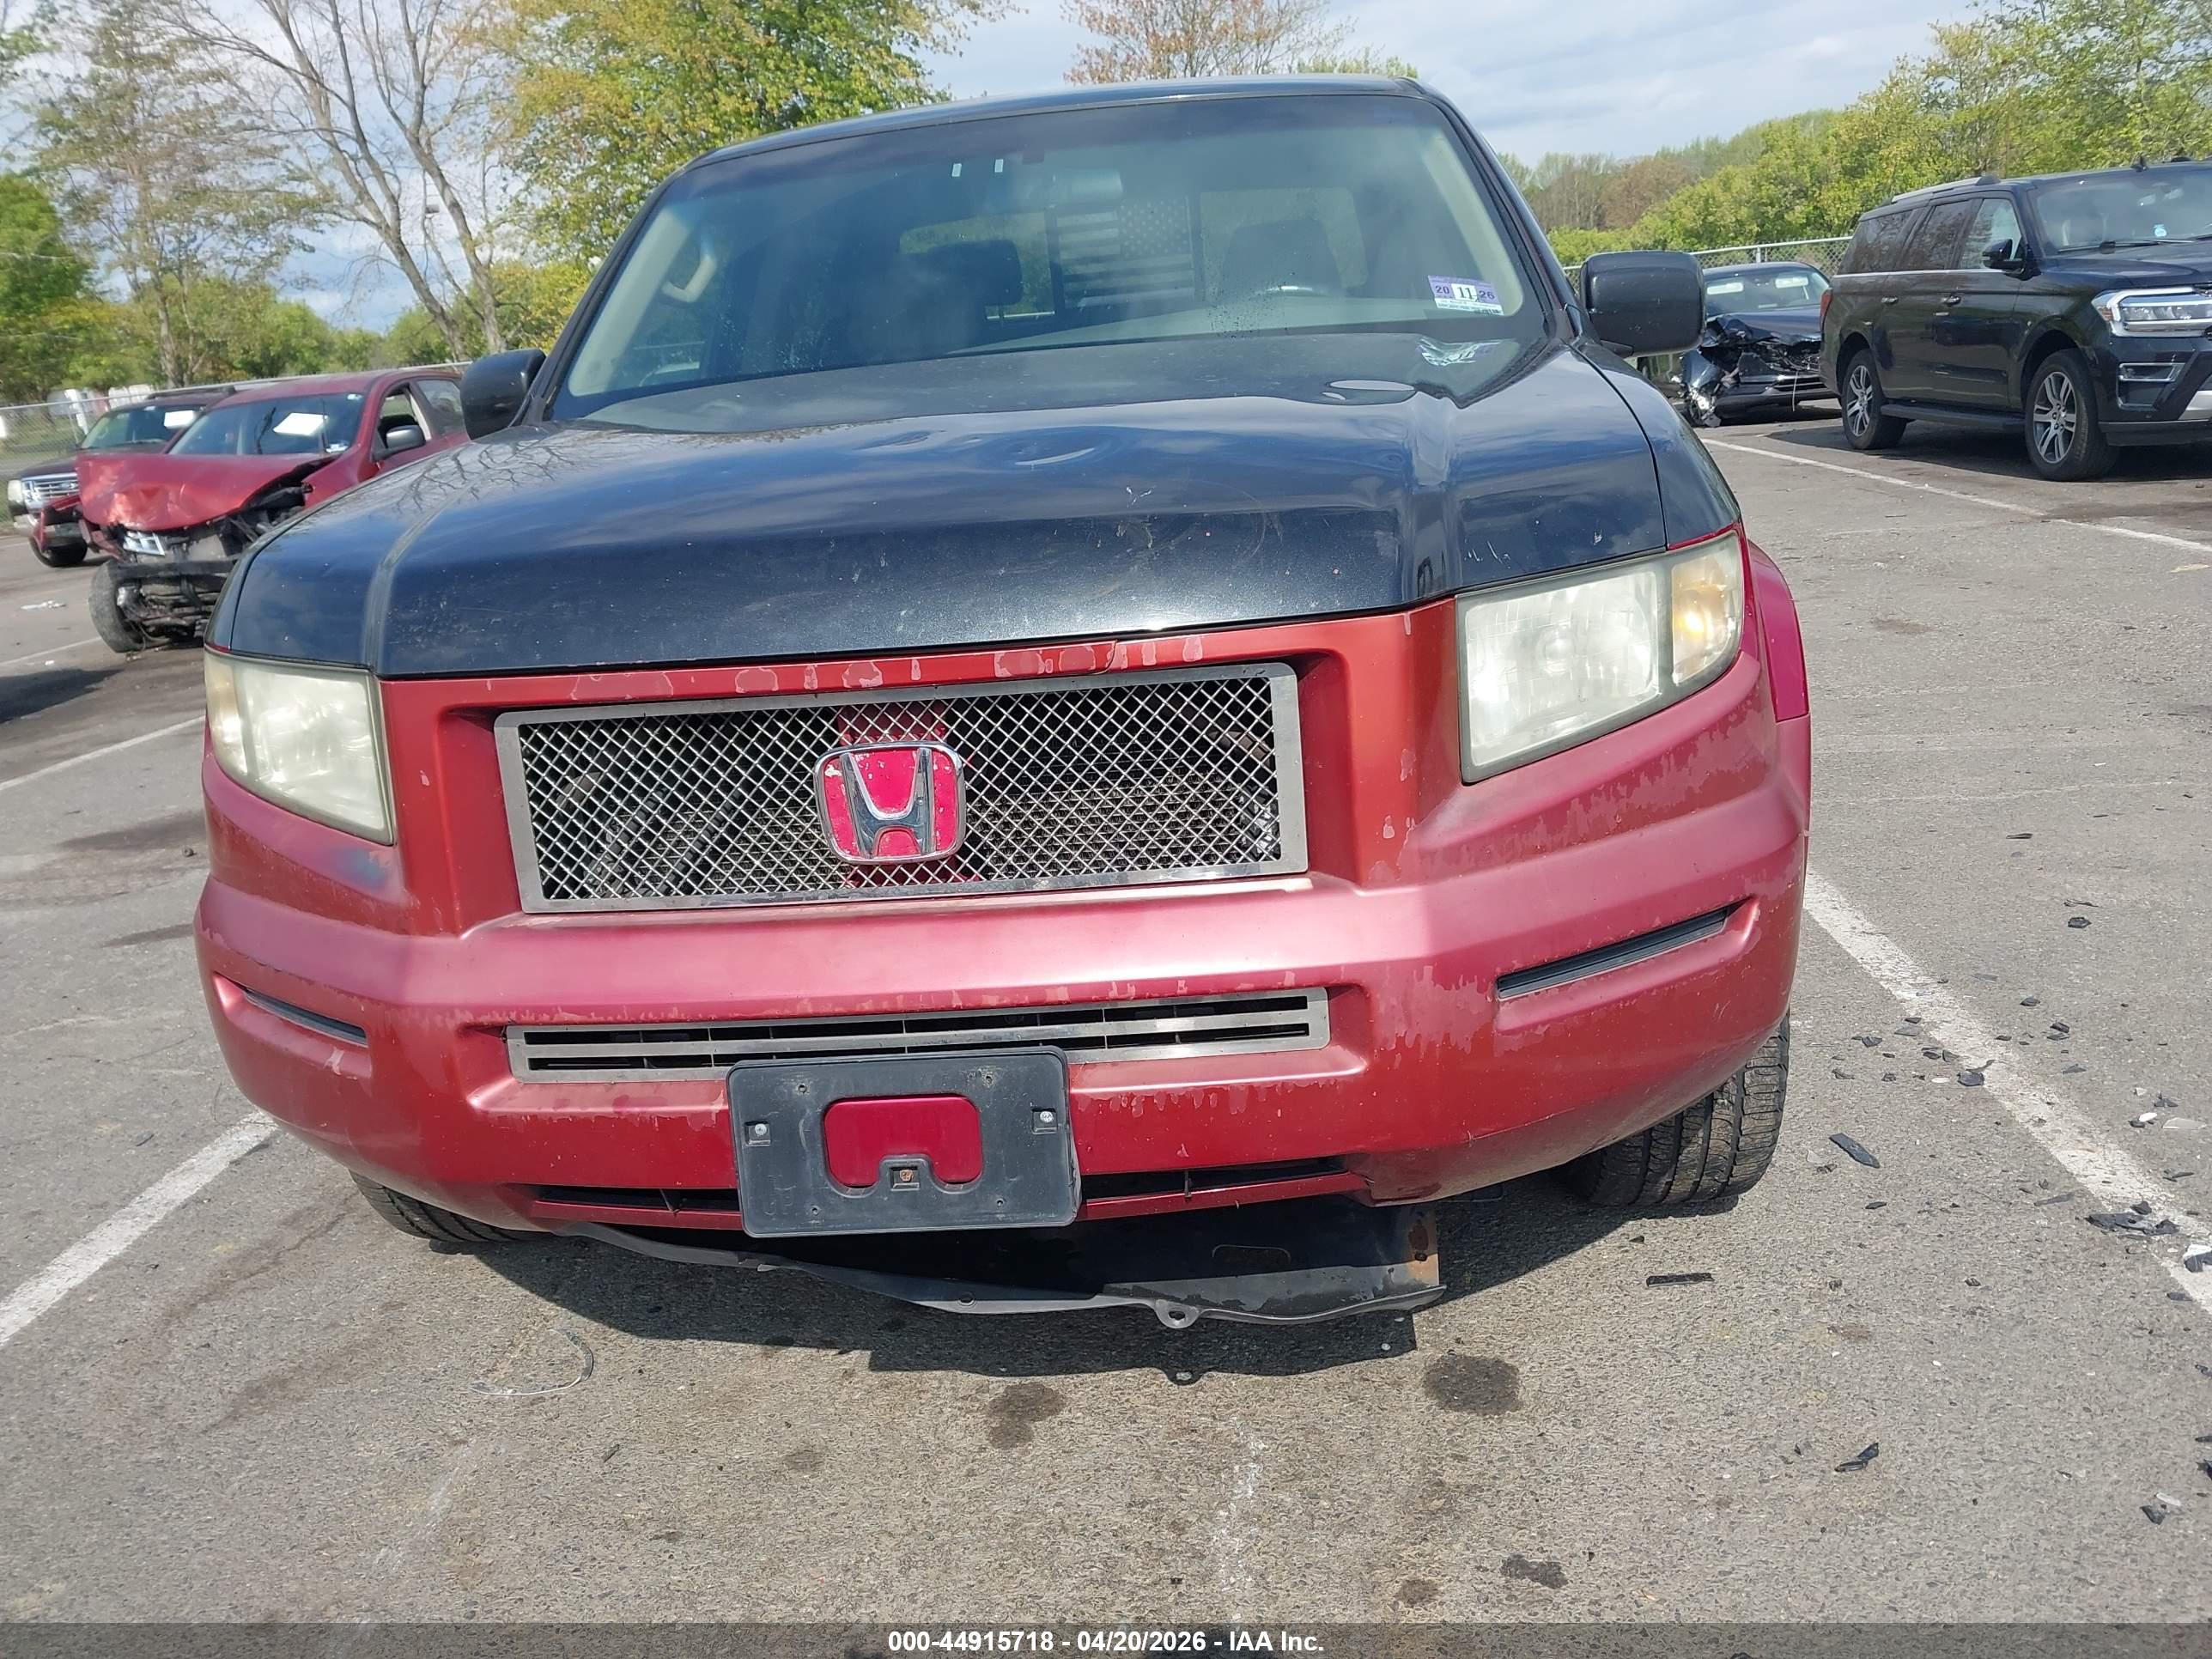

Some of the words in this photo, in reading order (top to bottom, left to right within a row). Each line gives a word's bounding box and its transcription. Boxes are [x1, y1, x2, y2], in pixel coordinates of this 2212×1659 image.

[1435, 285, 1450, 295] 20
[1457, 286, 1474, 300] 11
[1479, 290, 1495, 300] 26
